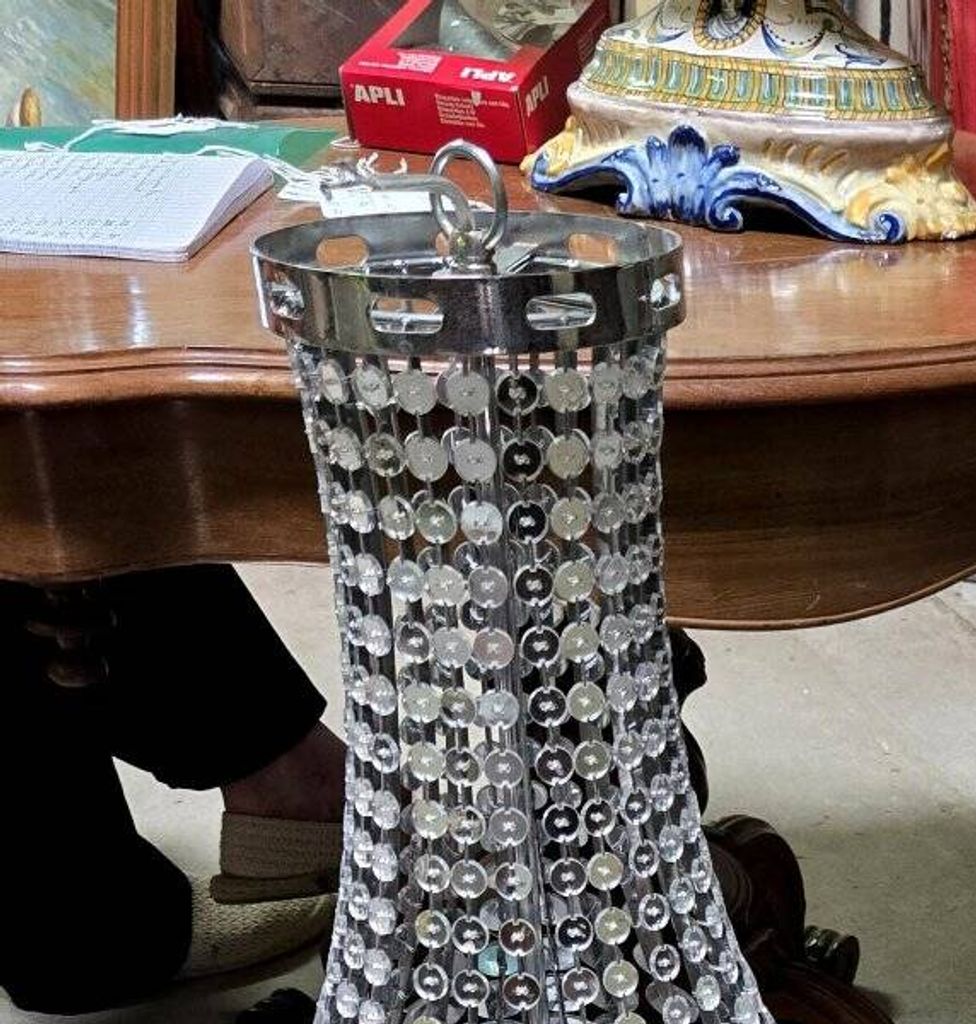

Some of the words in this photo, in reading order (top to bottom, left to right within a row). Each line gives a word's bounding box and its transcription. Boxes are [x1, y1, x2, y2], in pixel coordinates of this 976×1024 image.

[459, 67, 517, 84] APLI
[353, 83, 406, 106] APLI
[525, 75, 550, 118] APLI
